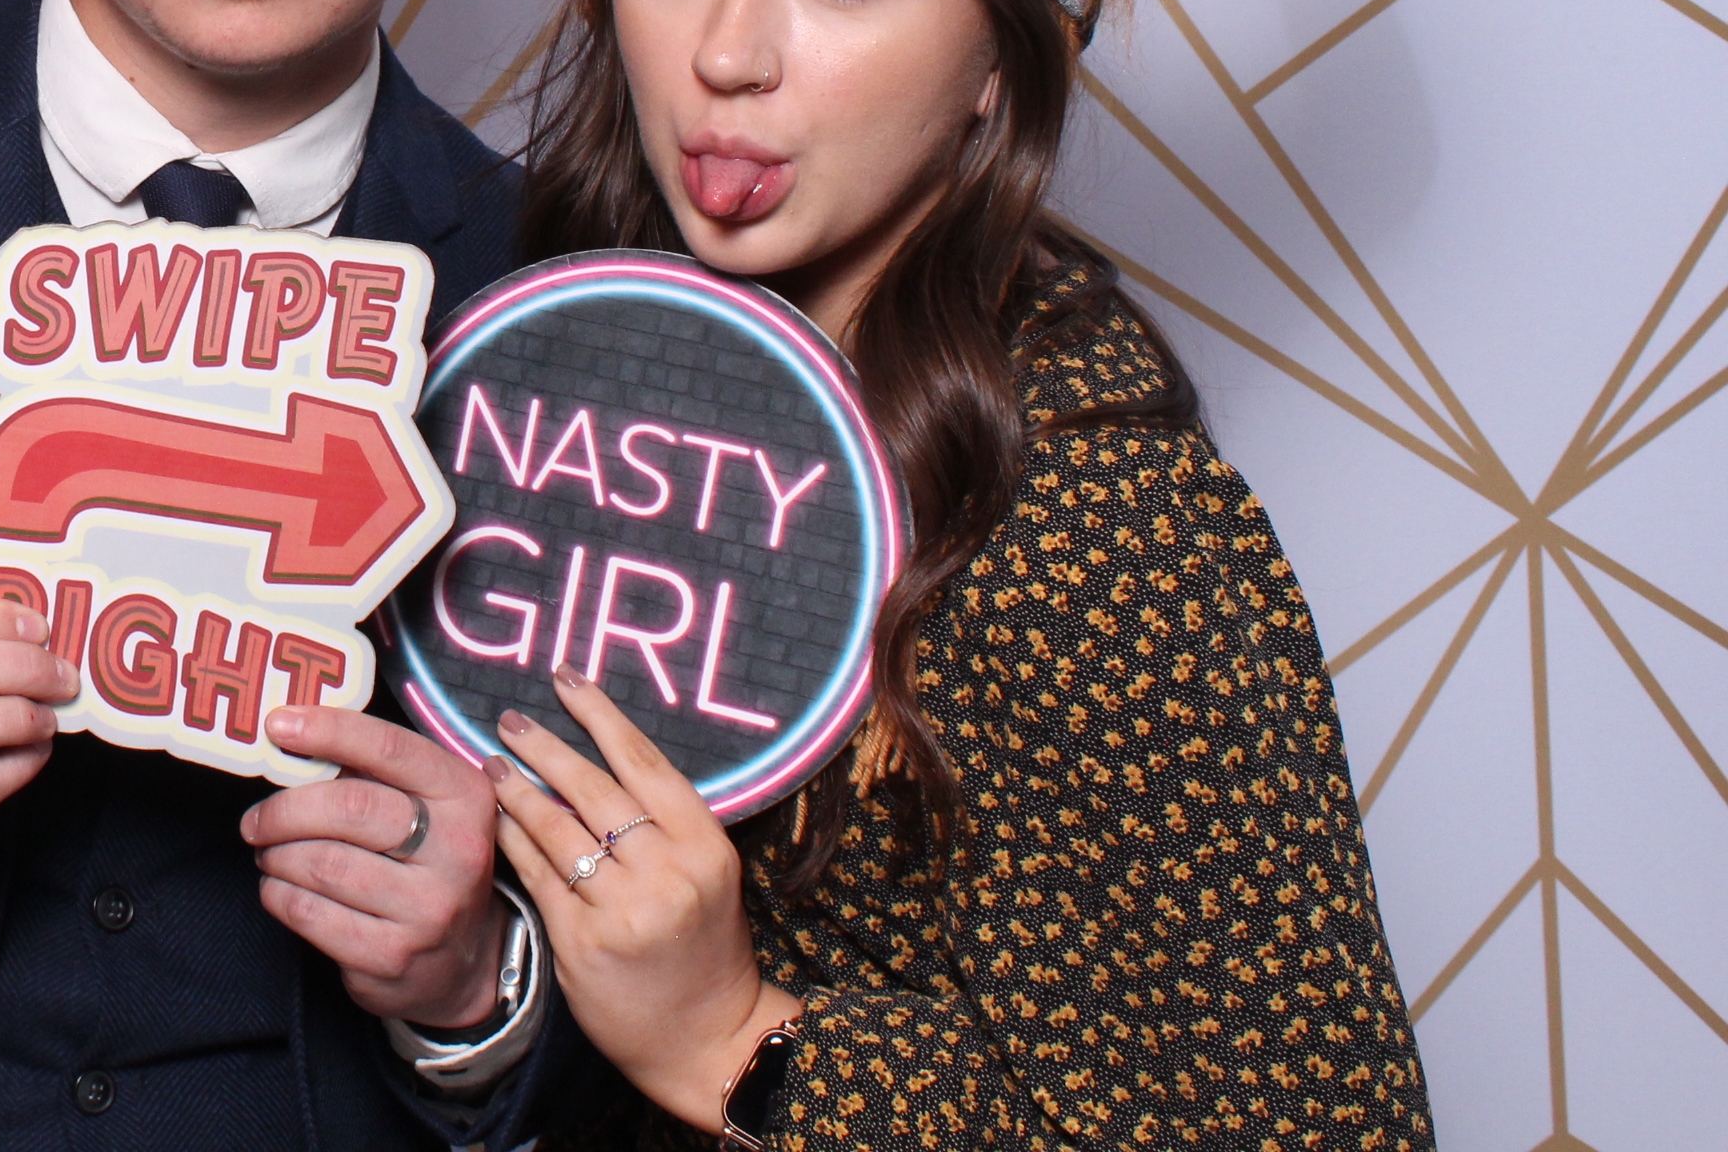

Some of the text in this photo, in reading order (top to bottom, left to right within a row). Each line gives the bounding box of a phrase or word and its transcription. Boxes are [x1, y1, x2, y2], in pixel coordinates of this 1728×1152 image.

[2, 242, 405, 386] SWIPE
[454, 384, 826, 549] NASTY
[433, 525, 778, 730] GIRL
